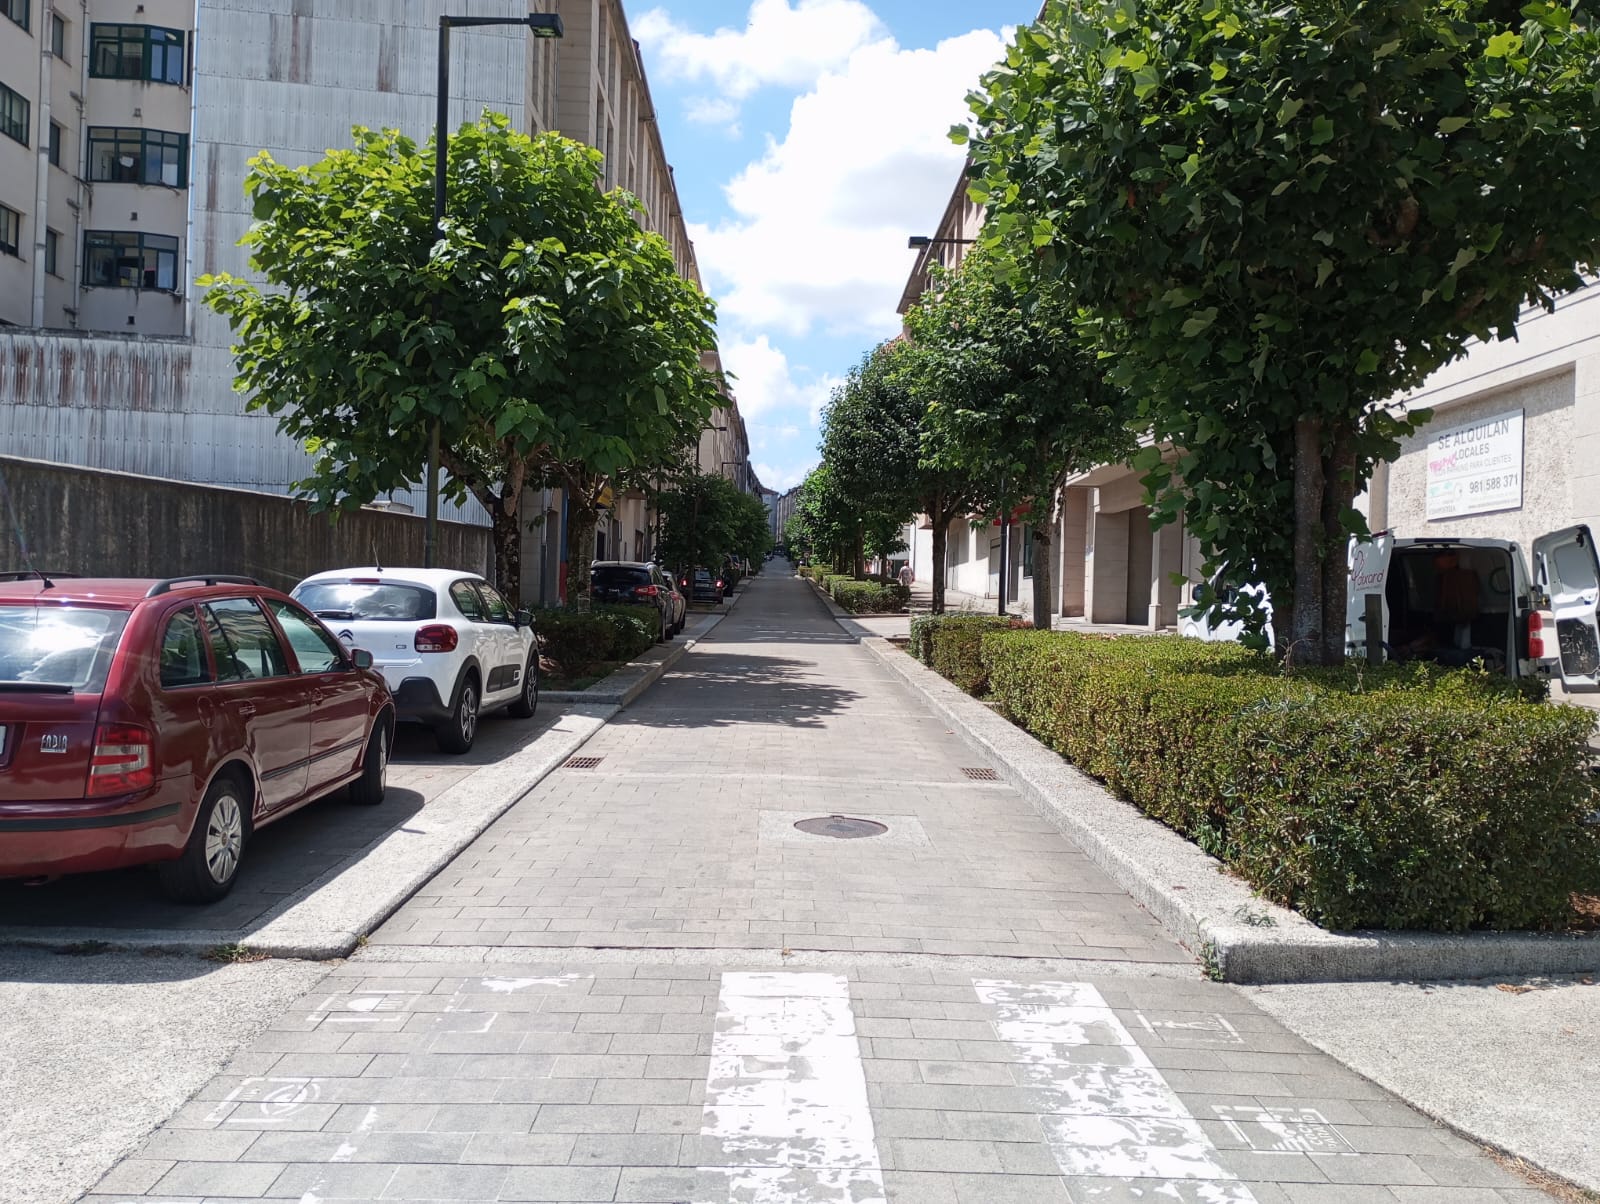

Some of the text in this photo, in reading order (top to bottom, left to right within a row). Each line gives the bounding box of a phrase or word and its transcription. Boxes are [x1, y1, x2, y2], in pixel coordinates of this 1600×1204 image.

[1438, 419, 1510, 450] SE ALQUILAN
[1454, 443, 1490, 460] LOCALES
[1484, 453, 1512, 467] CLIENTES
[1470, 474, 1519, 494] 981 588 371
